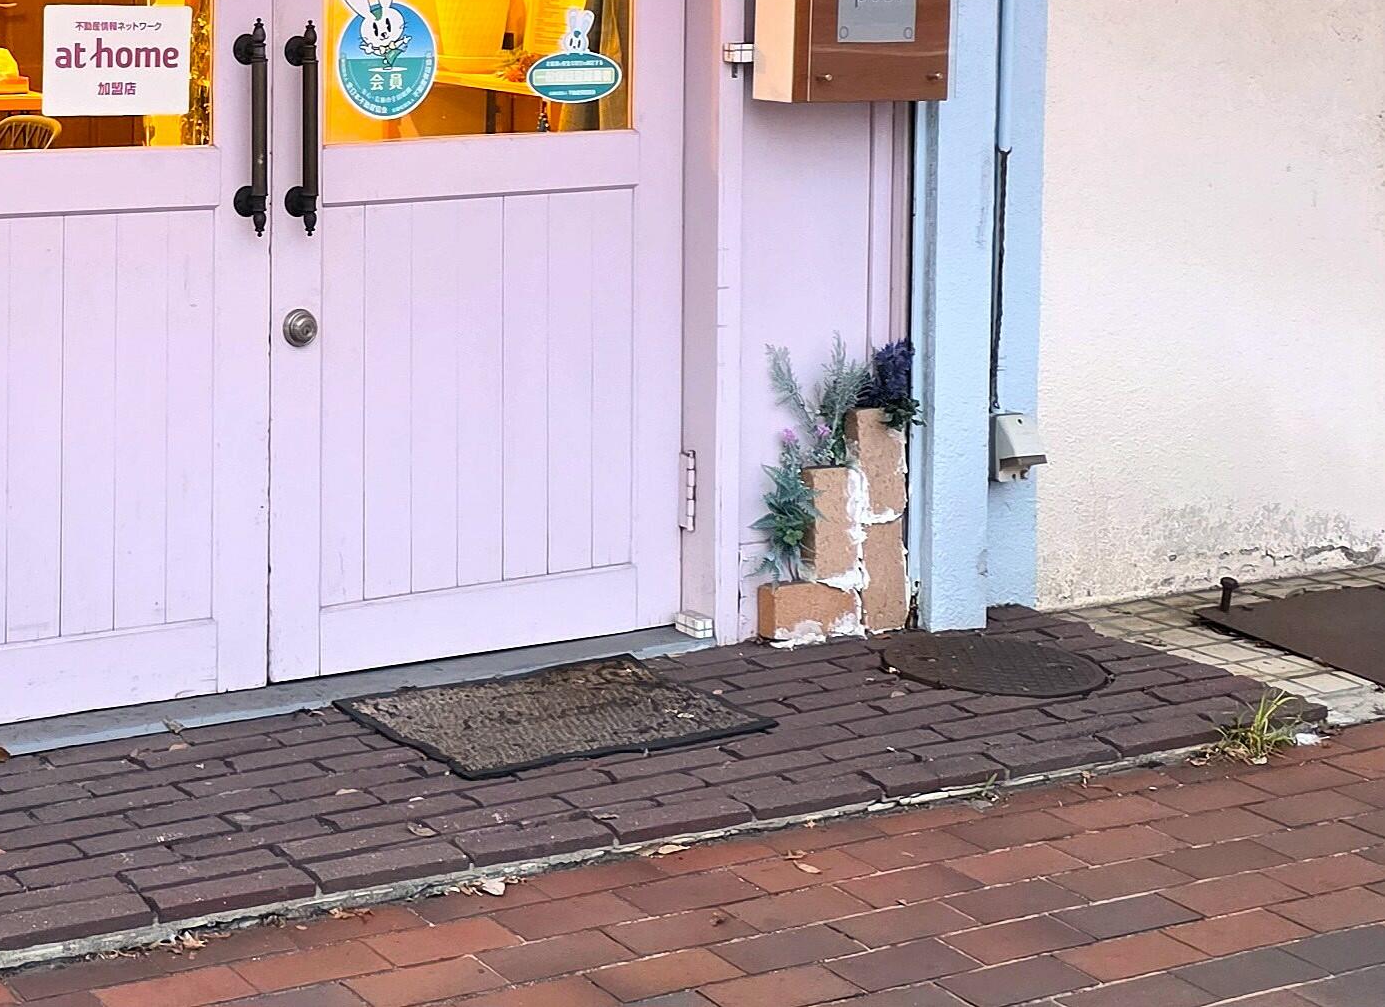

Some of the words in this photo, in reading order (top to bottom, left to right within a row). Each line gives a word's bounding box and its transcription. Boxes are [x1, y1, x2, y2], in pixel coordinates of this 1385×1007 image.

[75, 21, 162, 31] 不動産情報ネットワーク
[55, 43, 87, 69] at
[89, 37, 180, 69] home
[97, 81, 137, 96] 加盟店
